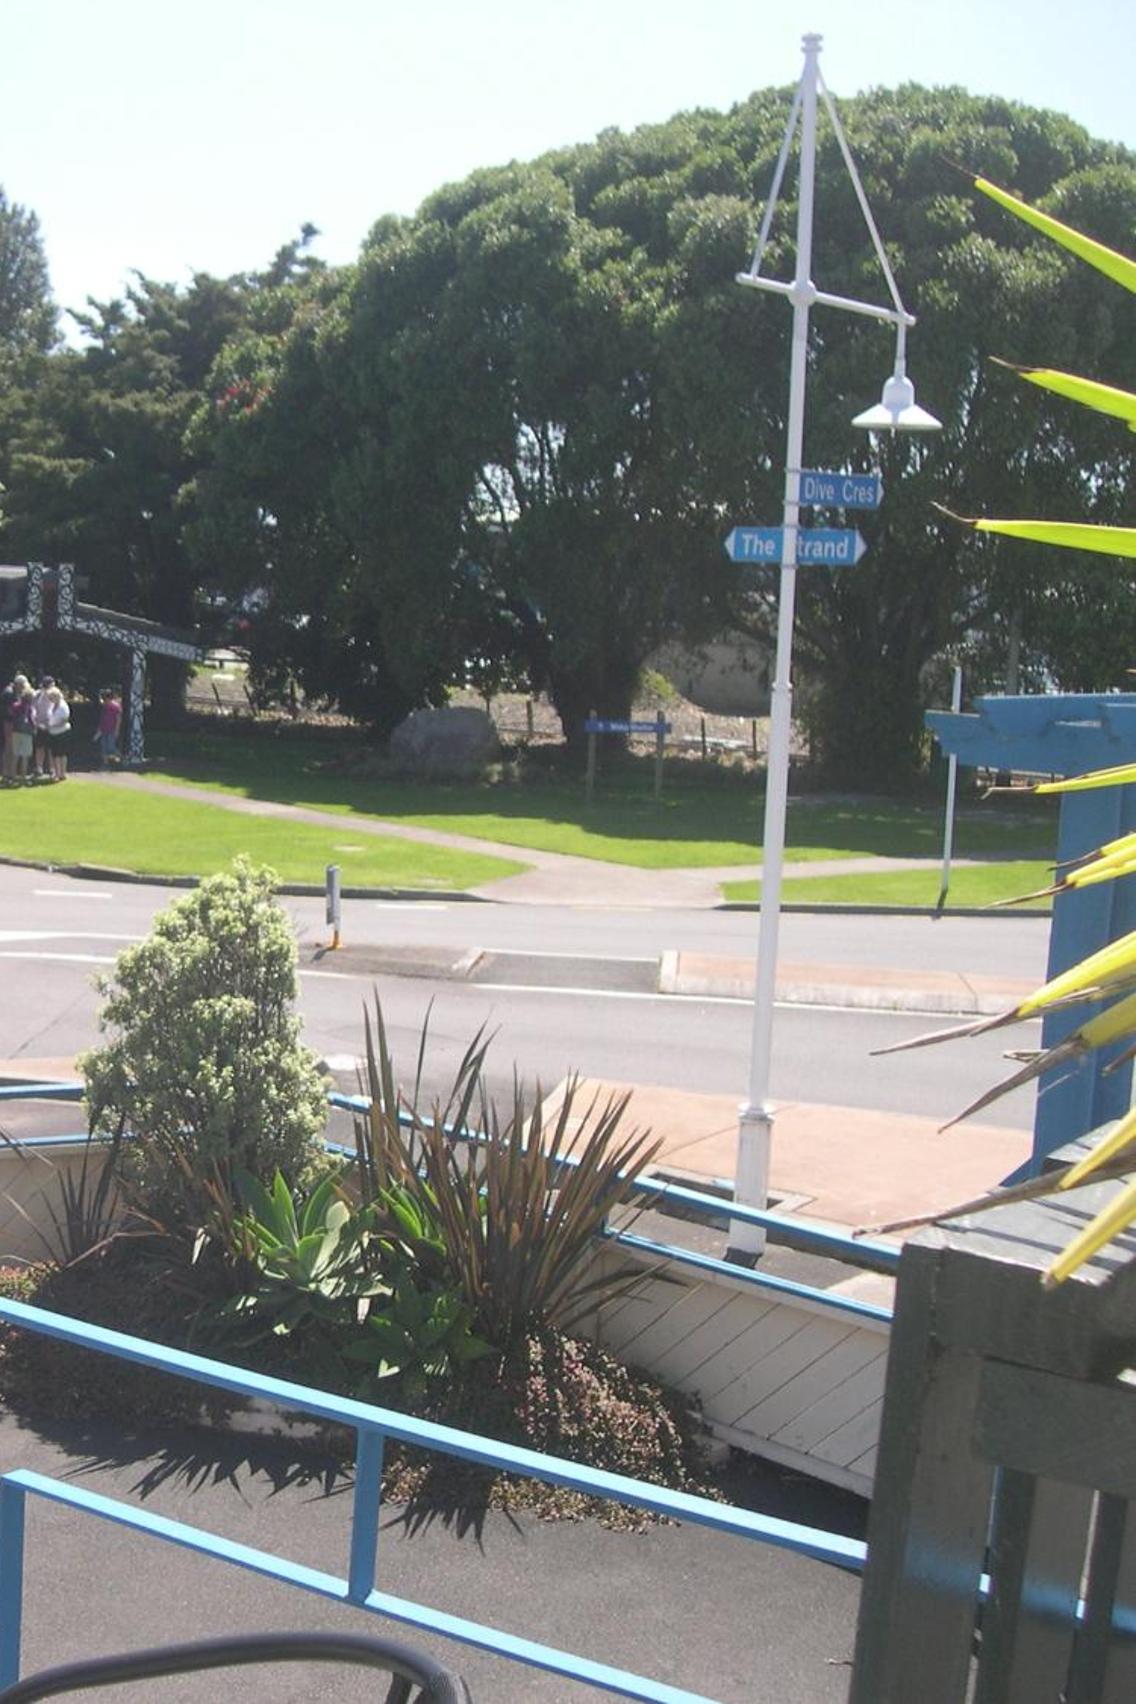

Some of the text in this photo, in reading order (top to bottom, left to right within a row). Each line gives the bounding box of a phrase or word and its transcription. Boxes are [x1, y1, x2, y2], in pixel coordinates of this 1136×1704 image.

[804, 477, 875, 503] Dive Cres
[742, 533, 848, 558] The trand
